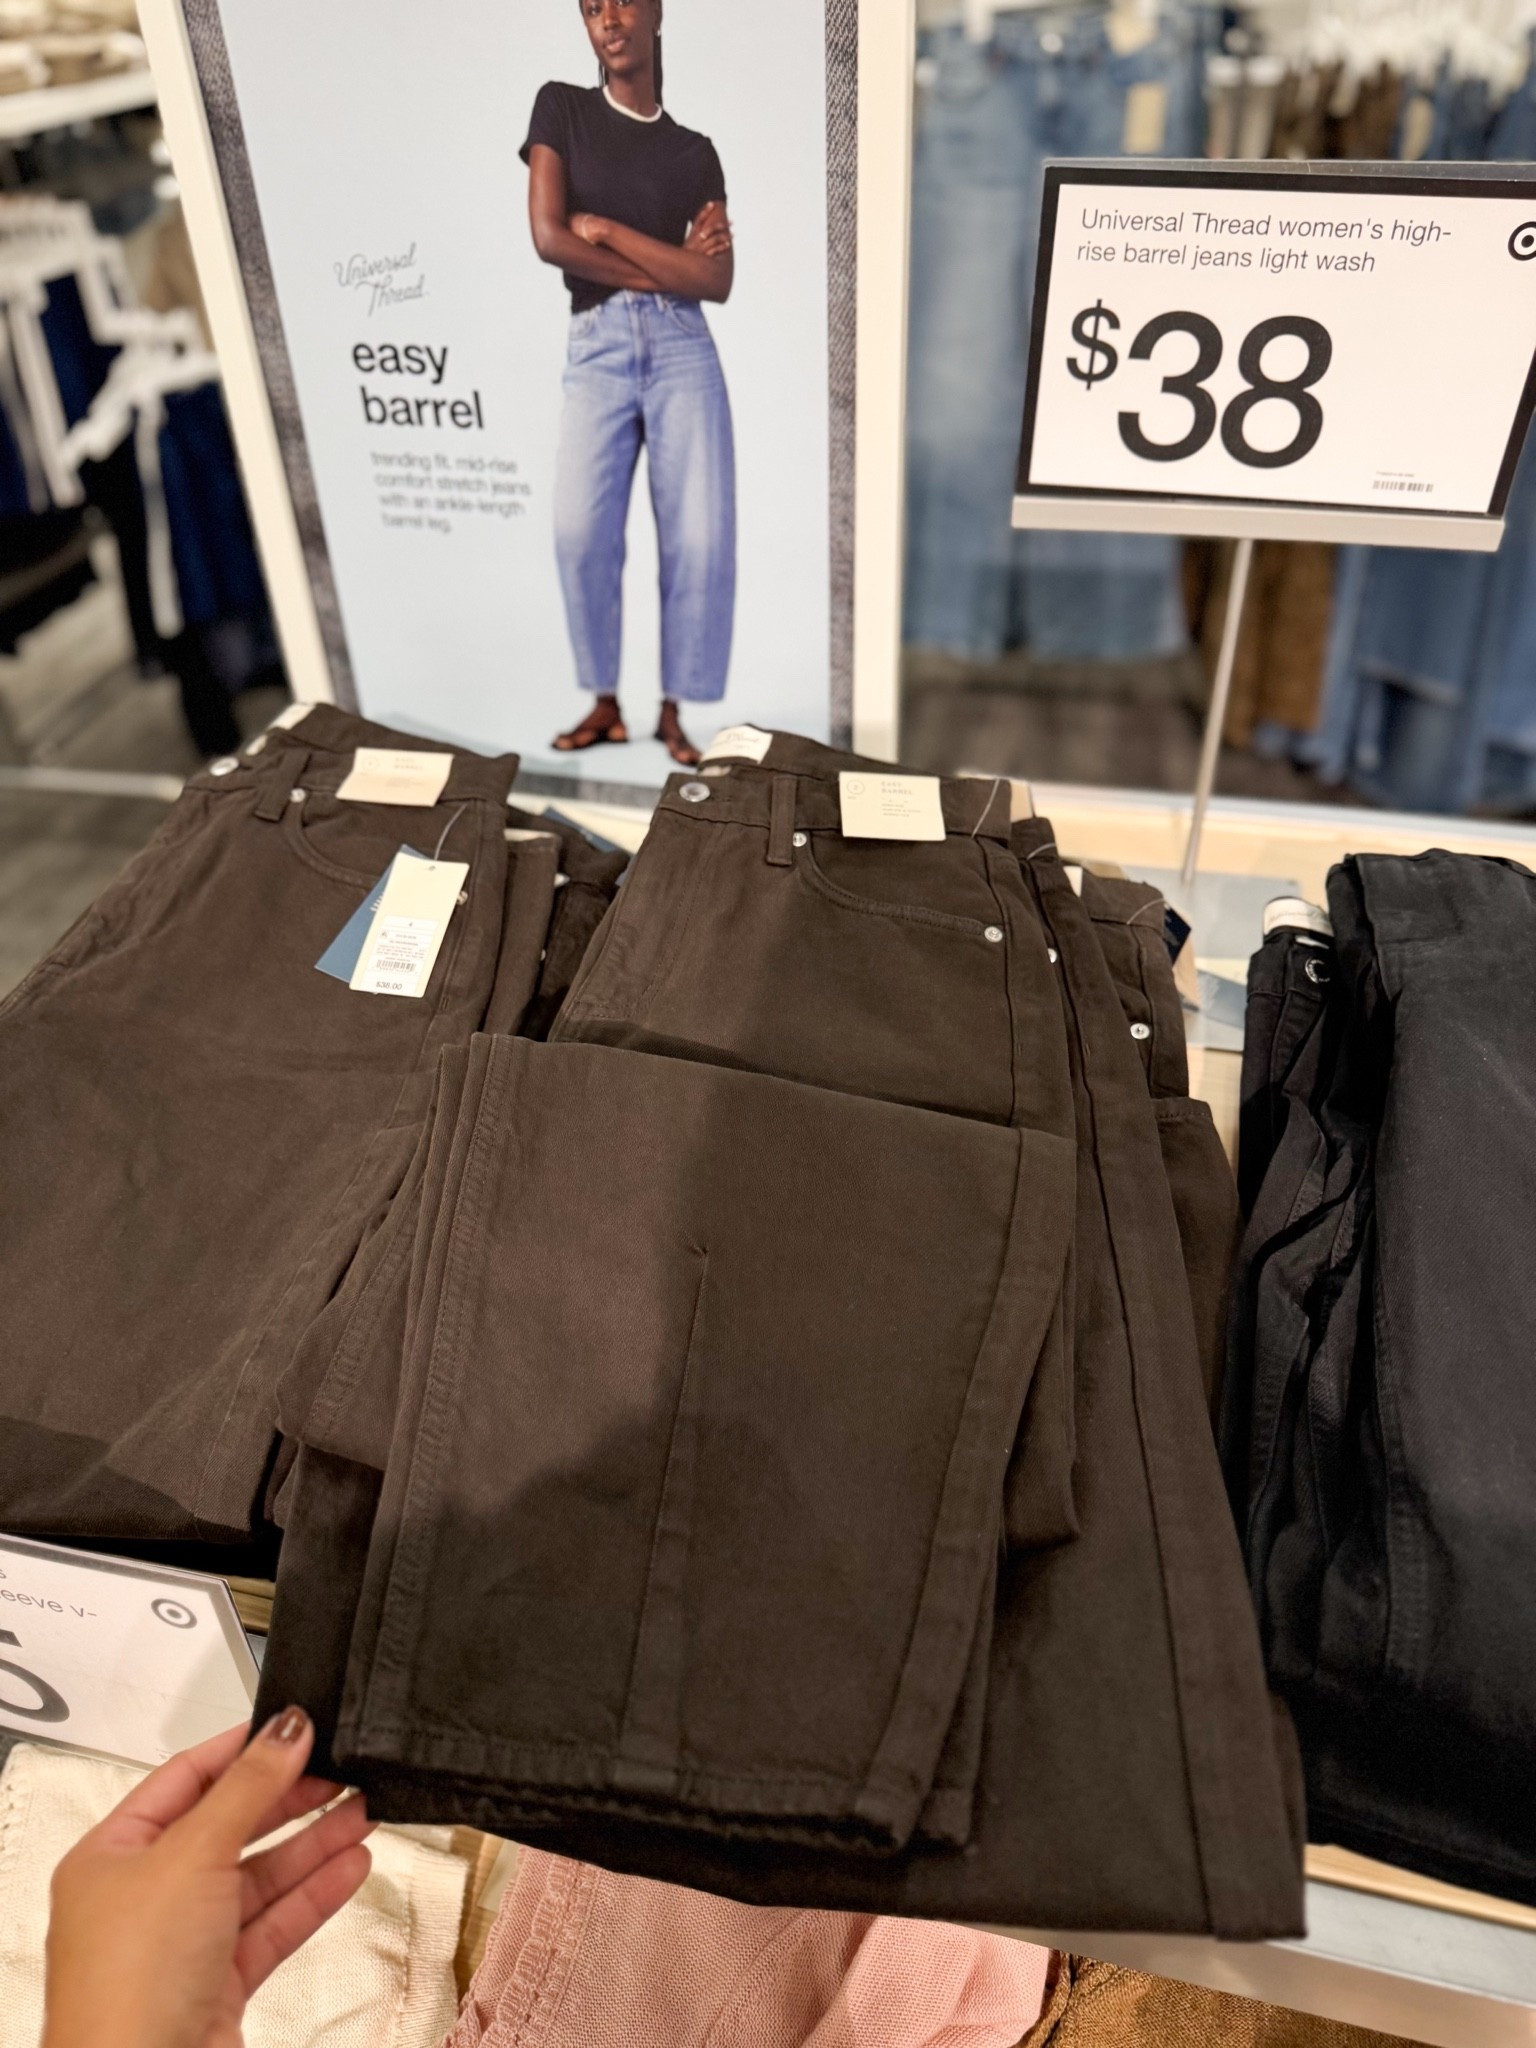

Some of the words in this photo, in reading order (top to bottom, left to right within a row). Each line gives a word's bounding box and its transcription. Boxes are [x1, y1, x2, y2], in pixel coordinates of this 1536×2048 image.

[1081, 207, 1185, 233] Universal
[1191, 211, 1272, 236] Thread
[1278, 218, 1384, 240] women's
[1390, 219, 1452, 247] high-
[333, 241, 417, 288] Universal
[1077, 241, 1116, 262] rise
[1123, 242, 1188, 265] barrel
[1191, 245, 1253, 271] jeans
[1259, 248, 1309, 274] light
[1316, 251, 1376, 273] wash
[354, 273, 425, 318] Thread
[352, 342, 448, 385] easy
[1066, 298, 1333, 469] $38
[360, 385, 484, 430] barrel
[370, 452, 431, 471] trending
[374, 474, 433, 489] comfort
[436, 477, 487, 492] stretch
[491, 480, 532, 496] jeans
[382, 512, 423, 529] barrel
